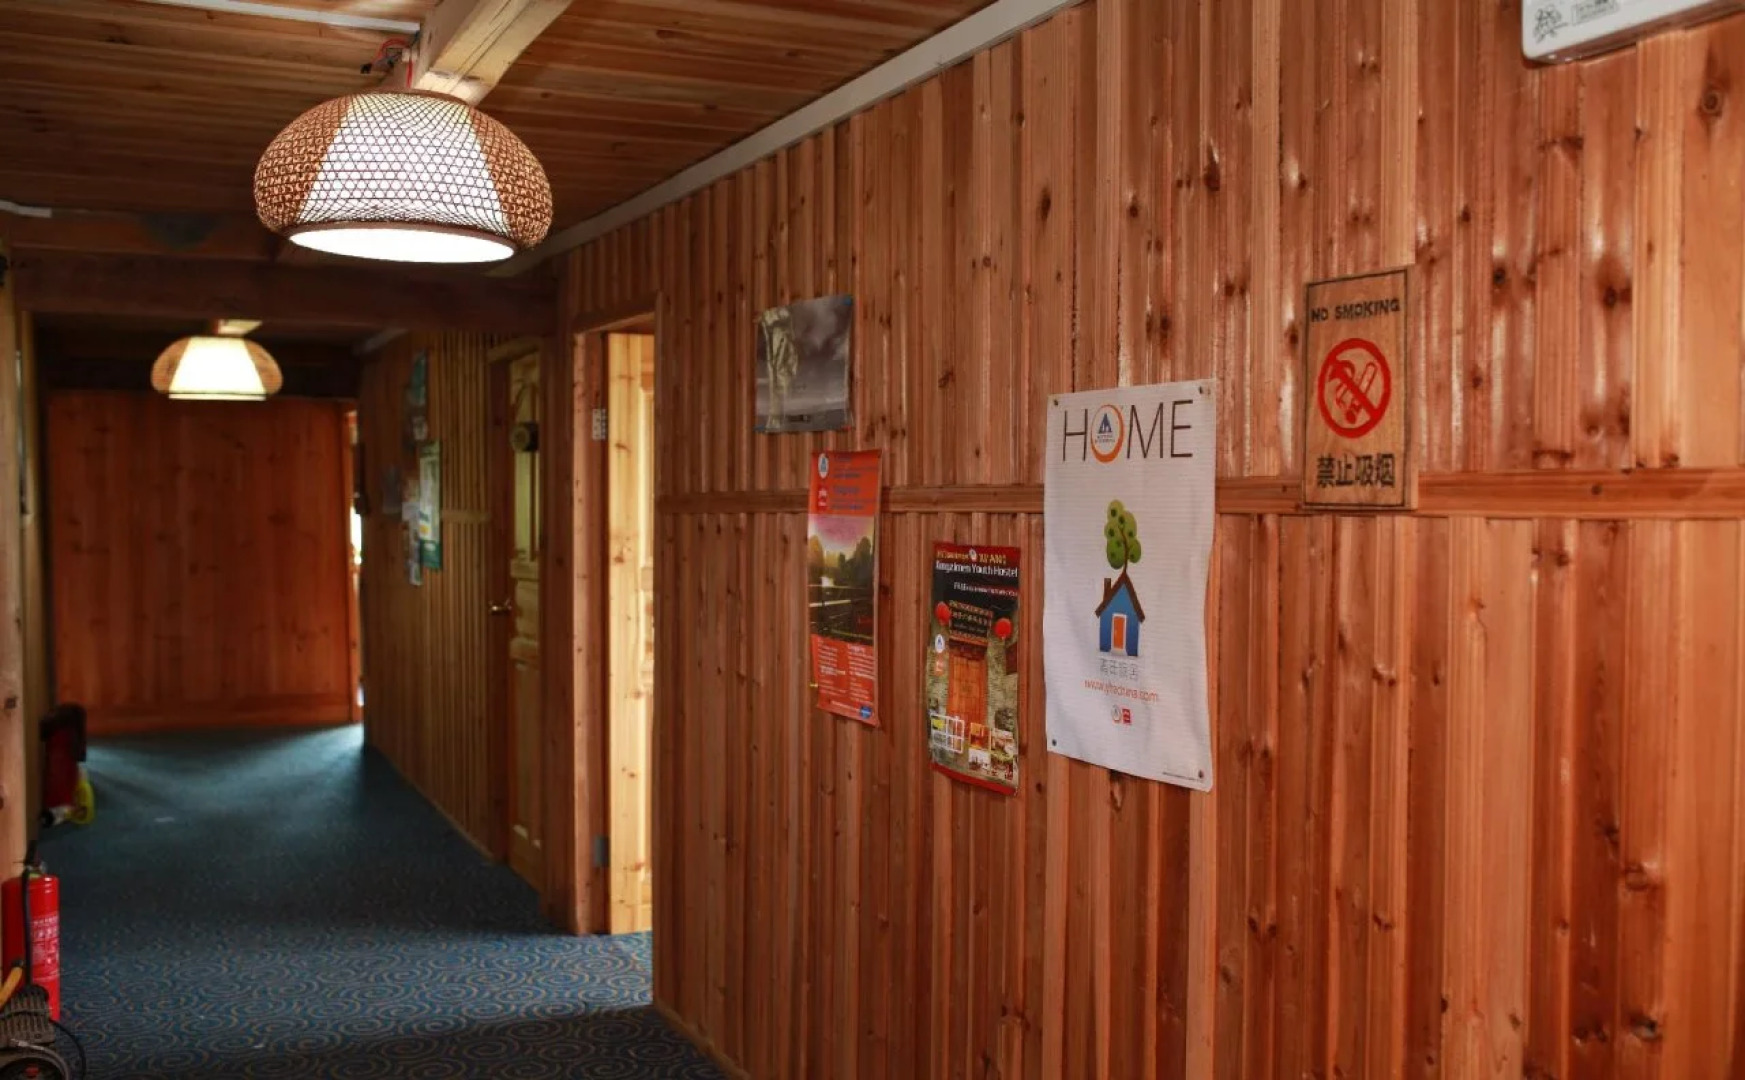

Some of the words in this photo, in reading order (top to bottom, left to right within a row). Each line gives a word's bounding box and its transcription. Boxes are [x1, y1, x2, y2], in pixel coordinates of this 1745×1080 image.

[1311, 307, 1329, 324] NO
[1335, 297, 1401, 322] SMOKING
[1062, 399, 1194, 464] HOME
[1317, 453, 1396, 488] 禁止吸烟
